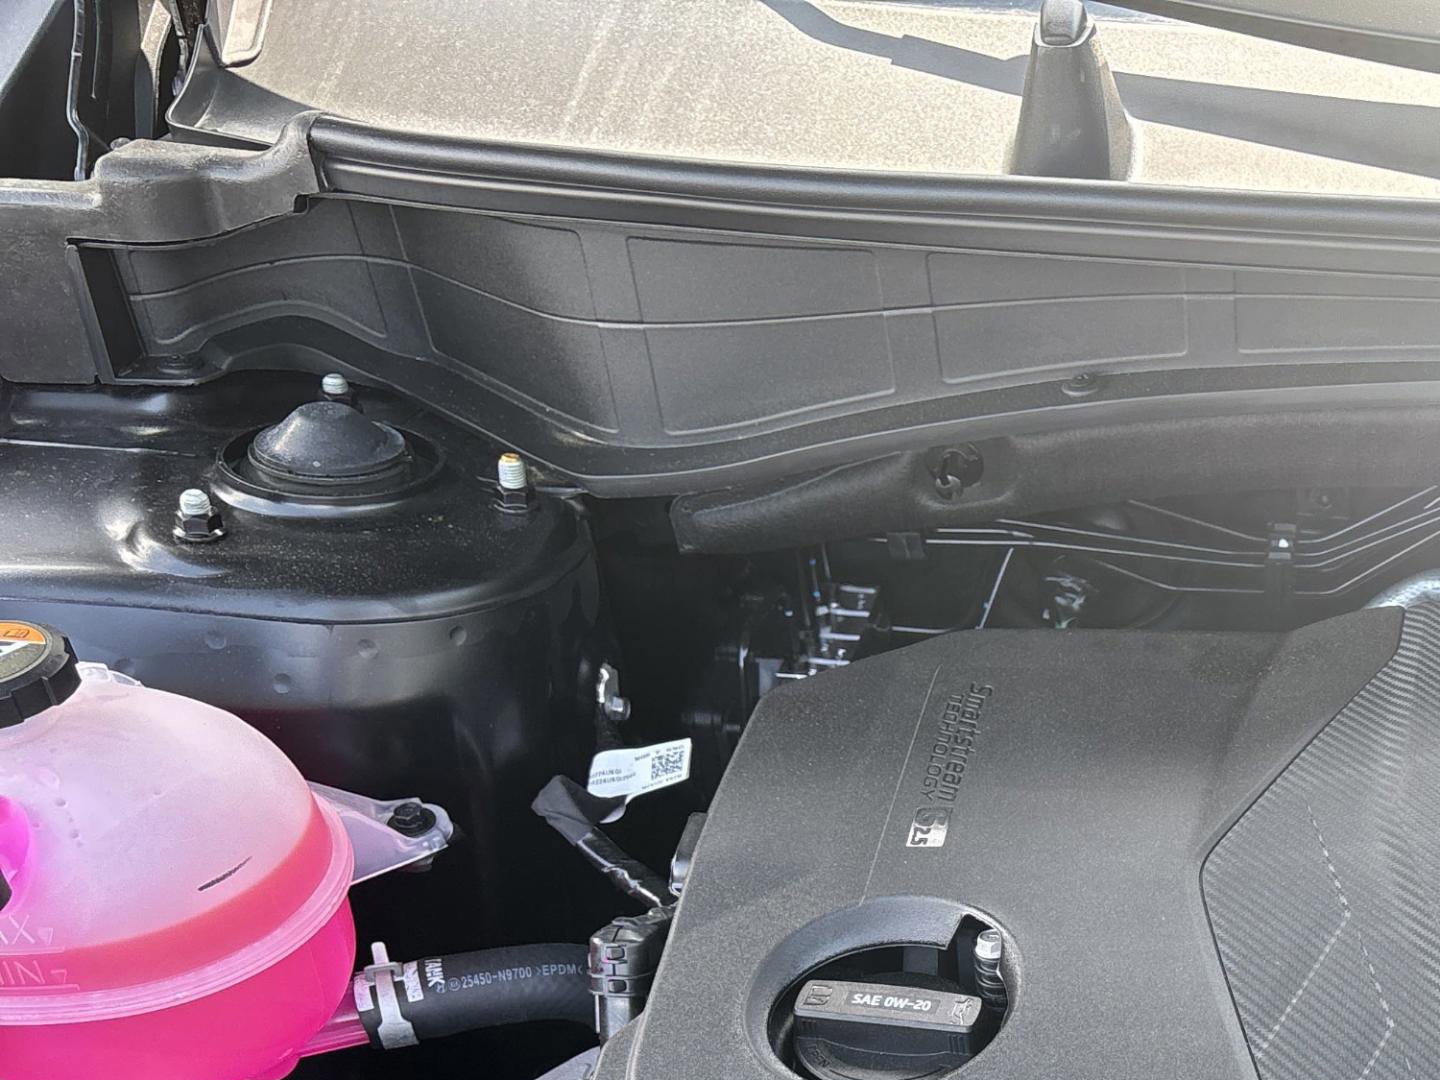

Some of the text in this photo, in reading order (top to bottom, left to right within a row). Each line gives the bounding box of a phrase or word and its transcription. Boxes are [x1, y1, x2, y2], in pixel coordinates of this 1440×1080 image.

[920, 694, 964, 801] TECHNOLOGY
[937, 681, 994, 802] Smartstream
[461, 966, 532, 989] 25450-N9700
[851, 993, 932, 1012] SAE 0W-20
